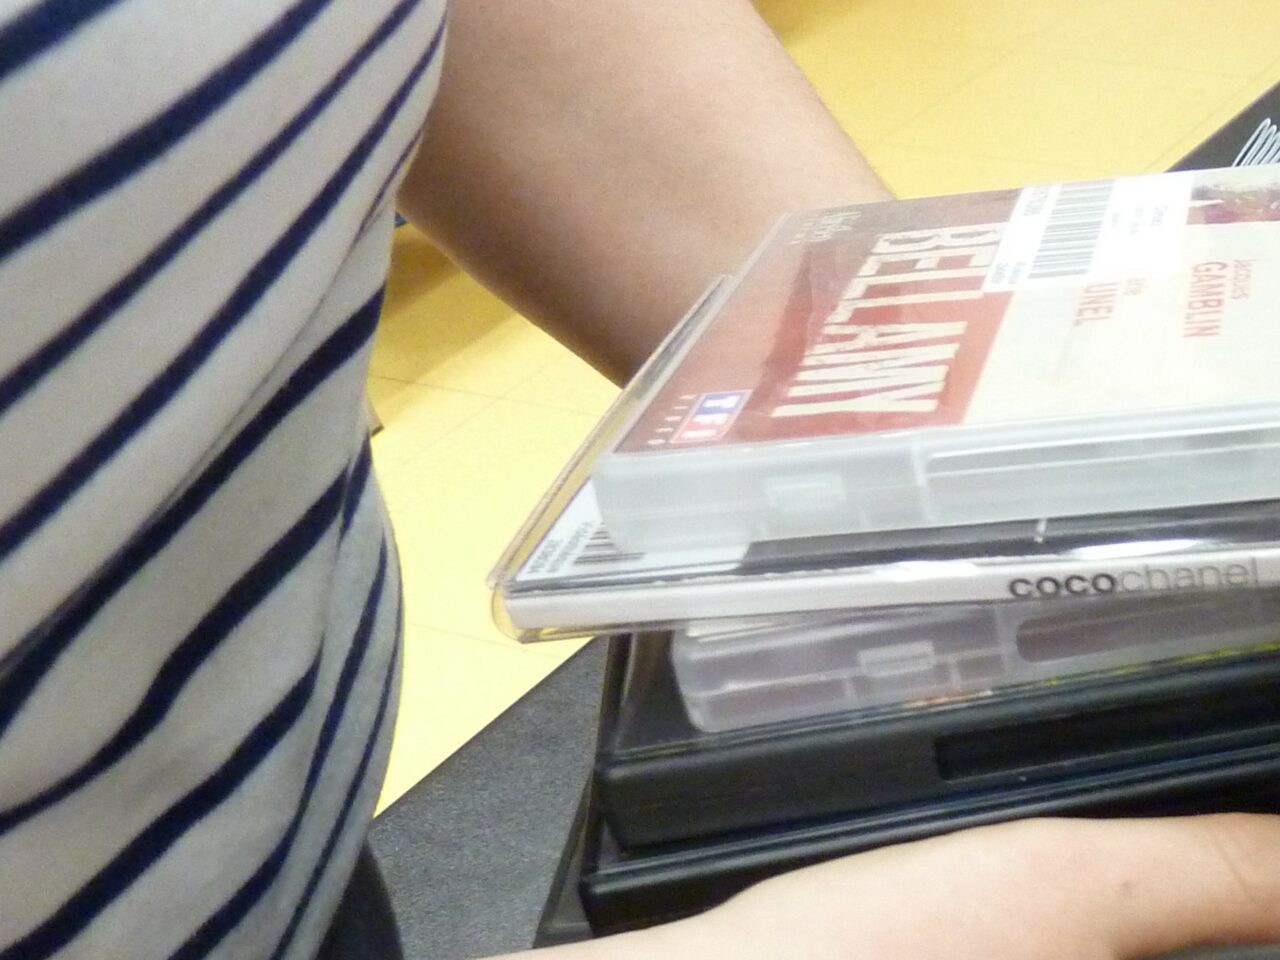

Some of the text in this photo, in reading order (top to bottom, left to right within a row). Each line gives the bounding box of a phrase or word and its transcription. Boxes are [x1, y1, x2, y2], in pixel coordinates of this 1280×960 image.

[770, 222, 1004, 419] BELLAMY
[1073, 281, 1121, 328] UNEL
[1183, 261, 1229, 338] GAMBLIN
